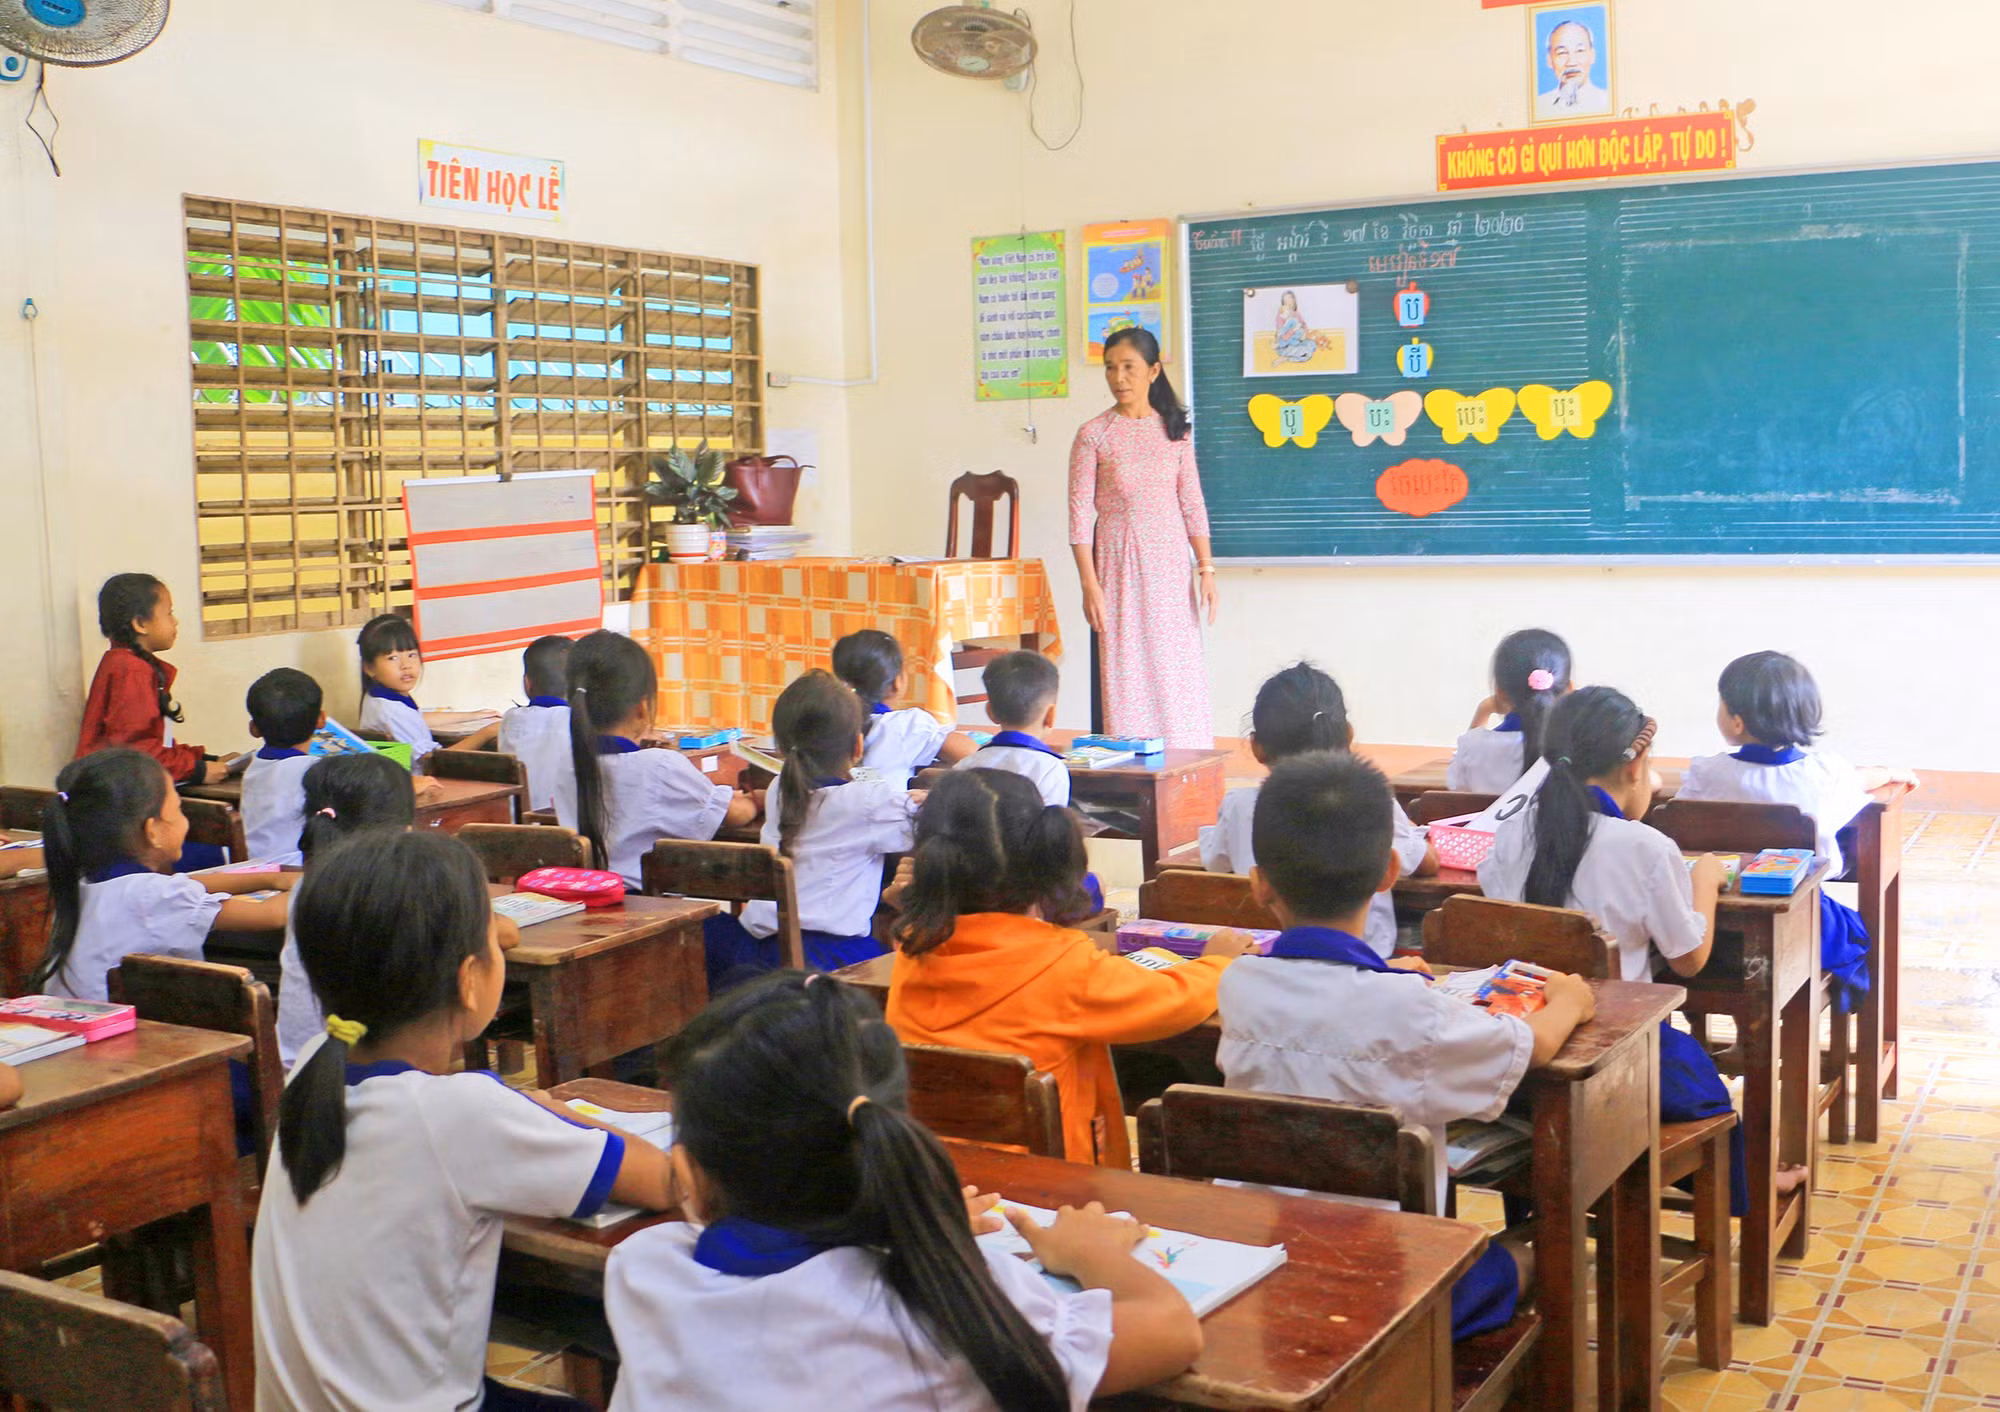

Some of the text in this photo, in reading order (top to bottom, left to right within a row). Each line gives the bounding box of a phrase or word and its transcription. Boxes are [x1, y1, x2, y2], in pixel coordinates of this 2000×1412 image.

[1447, 142, 1495, 179] KHÔNG
[1498, 138, 1517, 175] CÓ
[1520, 136, 1535, 174] GÌ
[1538, 134, 1563, 176] QUÍ
[1565, 132, 1595, 169] HƠN
[1598, 128, 1630, 172] ĐỘC
[1670, 124, 1692, 167] TỰ
[1695, 129, 1717, 159] DO
[427, 156, 561, 214] TIÊN HỌC LỄ
